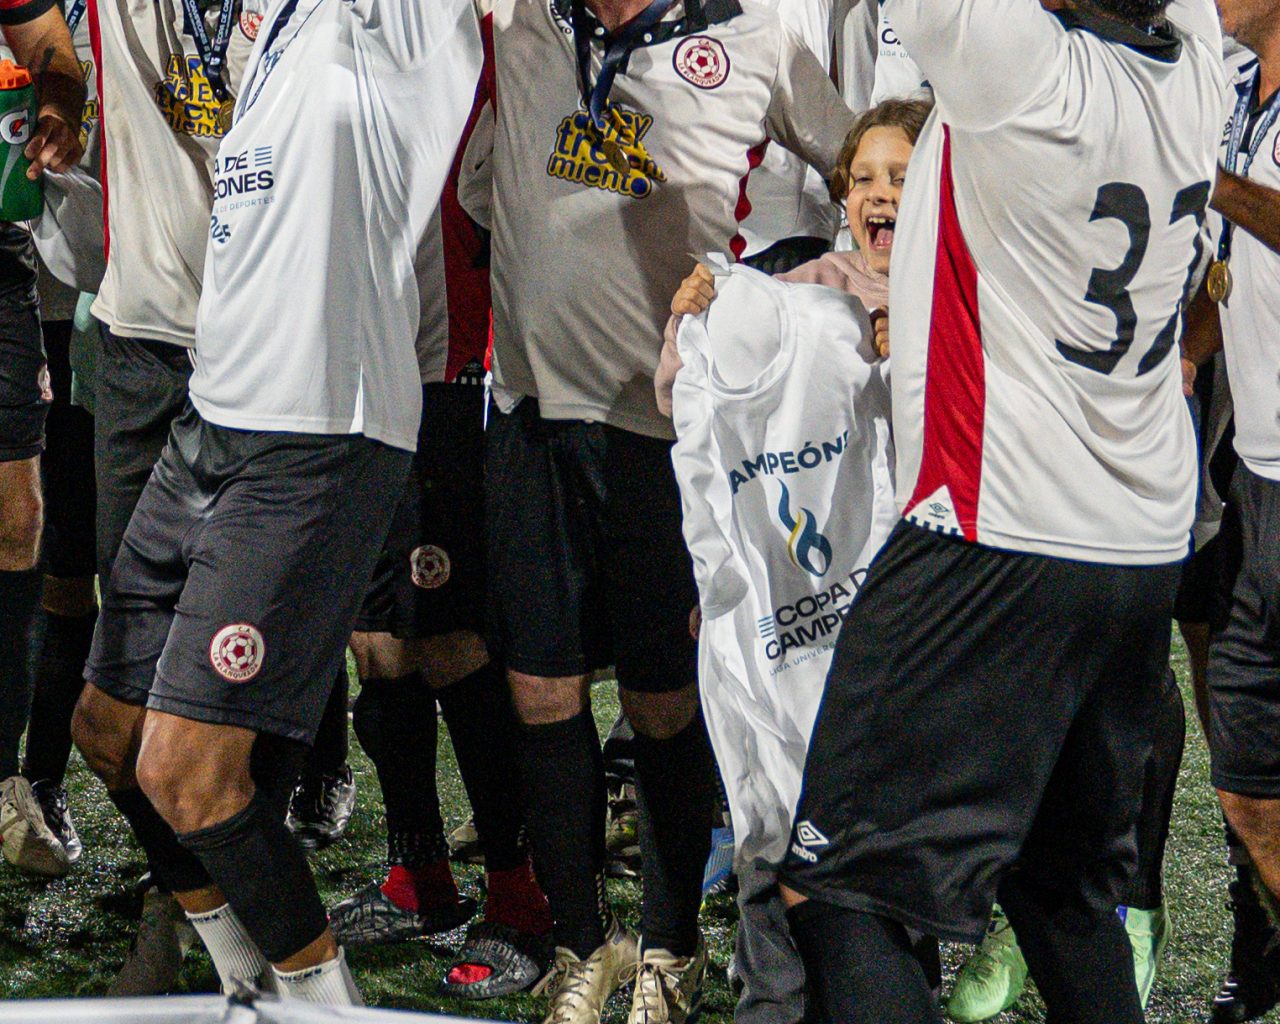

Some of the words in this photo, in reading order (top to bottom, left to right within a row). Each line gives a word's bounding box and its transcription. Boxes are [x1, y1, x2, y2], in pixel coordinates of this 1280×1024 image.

[188, 0, 208, 45] CAMPEONES
[220, 11, 228, 25] DE
[0, 108, 30, 145] G
[223, 149, 248, 174] DE
[729, 429, 849, 495] AMPEÓN!
[774, 581, 851, 627] COPA
[848, 567, 870, 592] D
